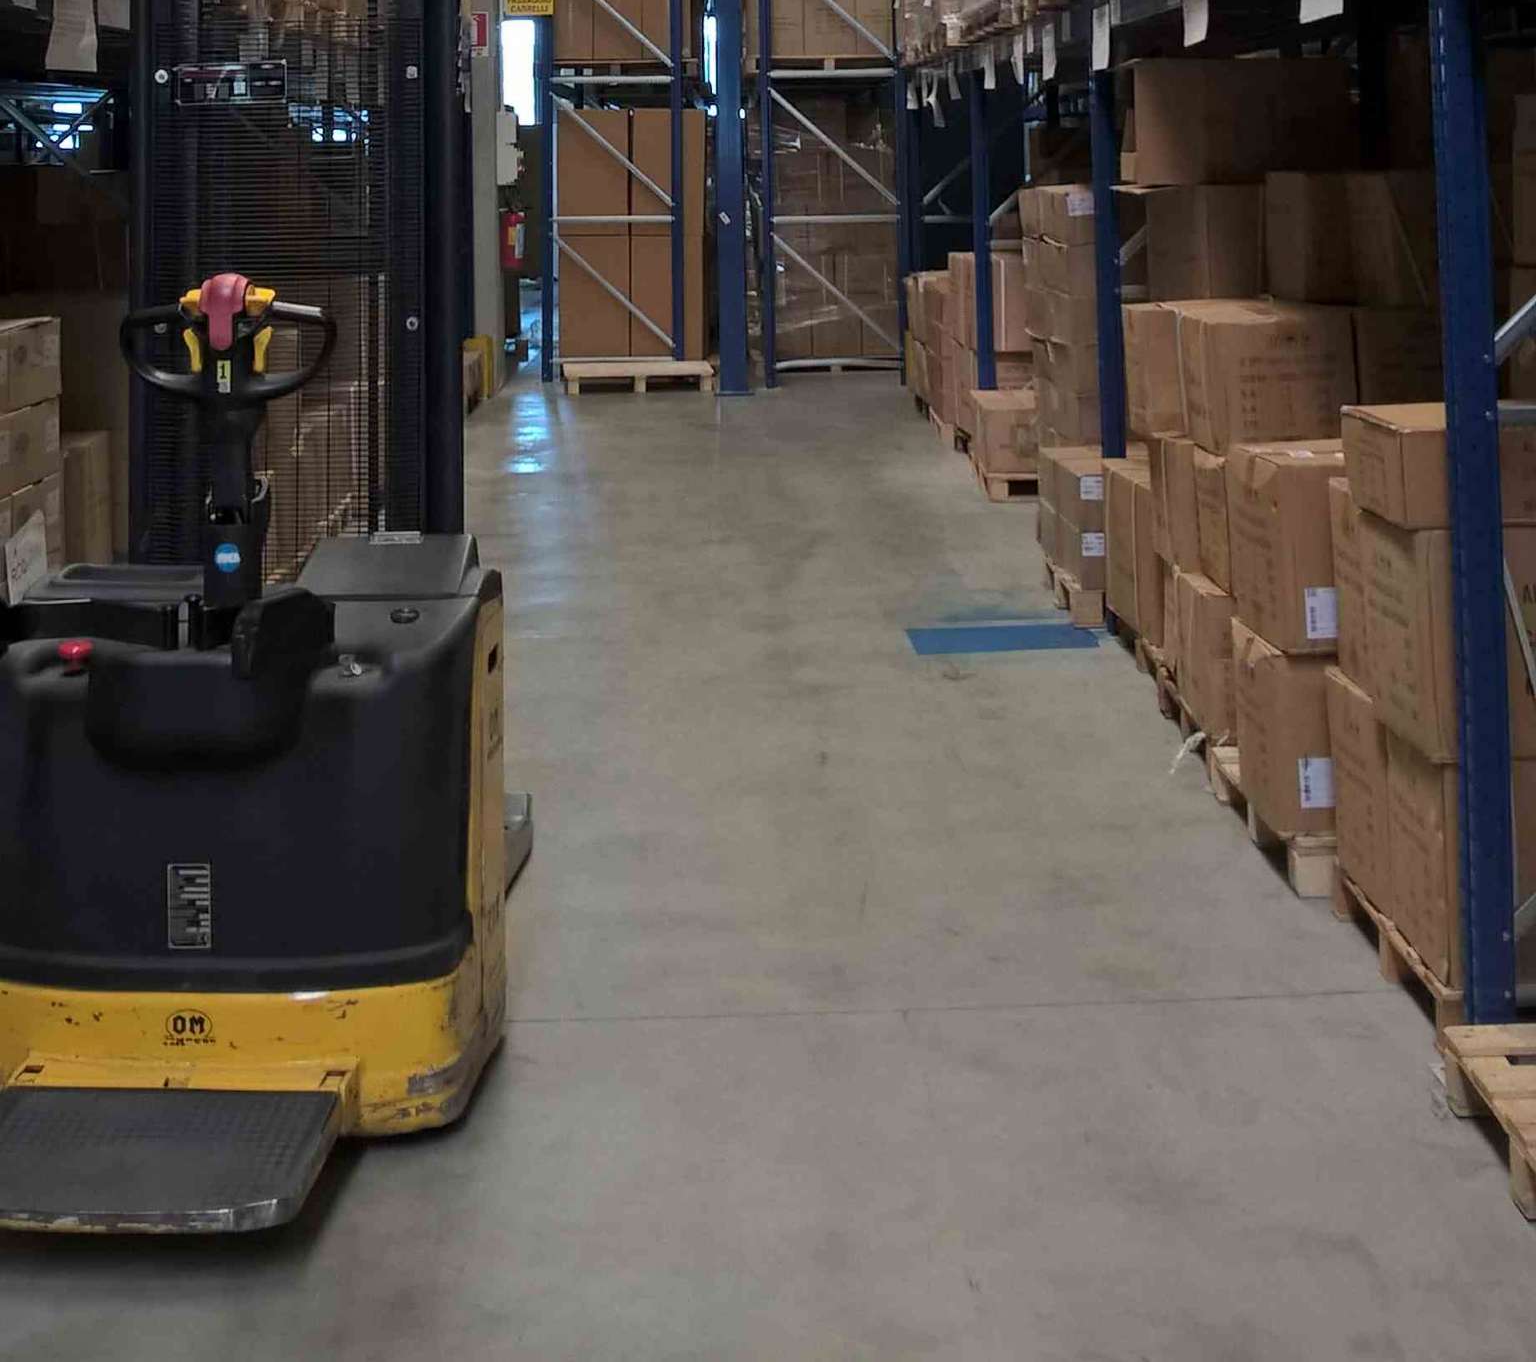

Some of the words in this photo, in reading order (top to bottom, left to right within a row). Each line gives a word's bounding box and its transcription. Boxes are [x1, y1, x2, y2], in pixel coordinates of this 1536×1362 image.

[510, 5, 548, 13] CARRELLI
[219, 363, 227, 380] 1
[172, 1015, 206, 1035] OM
